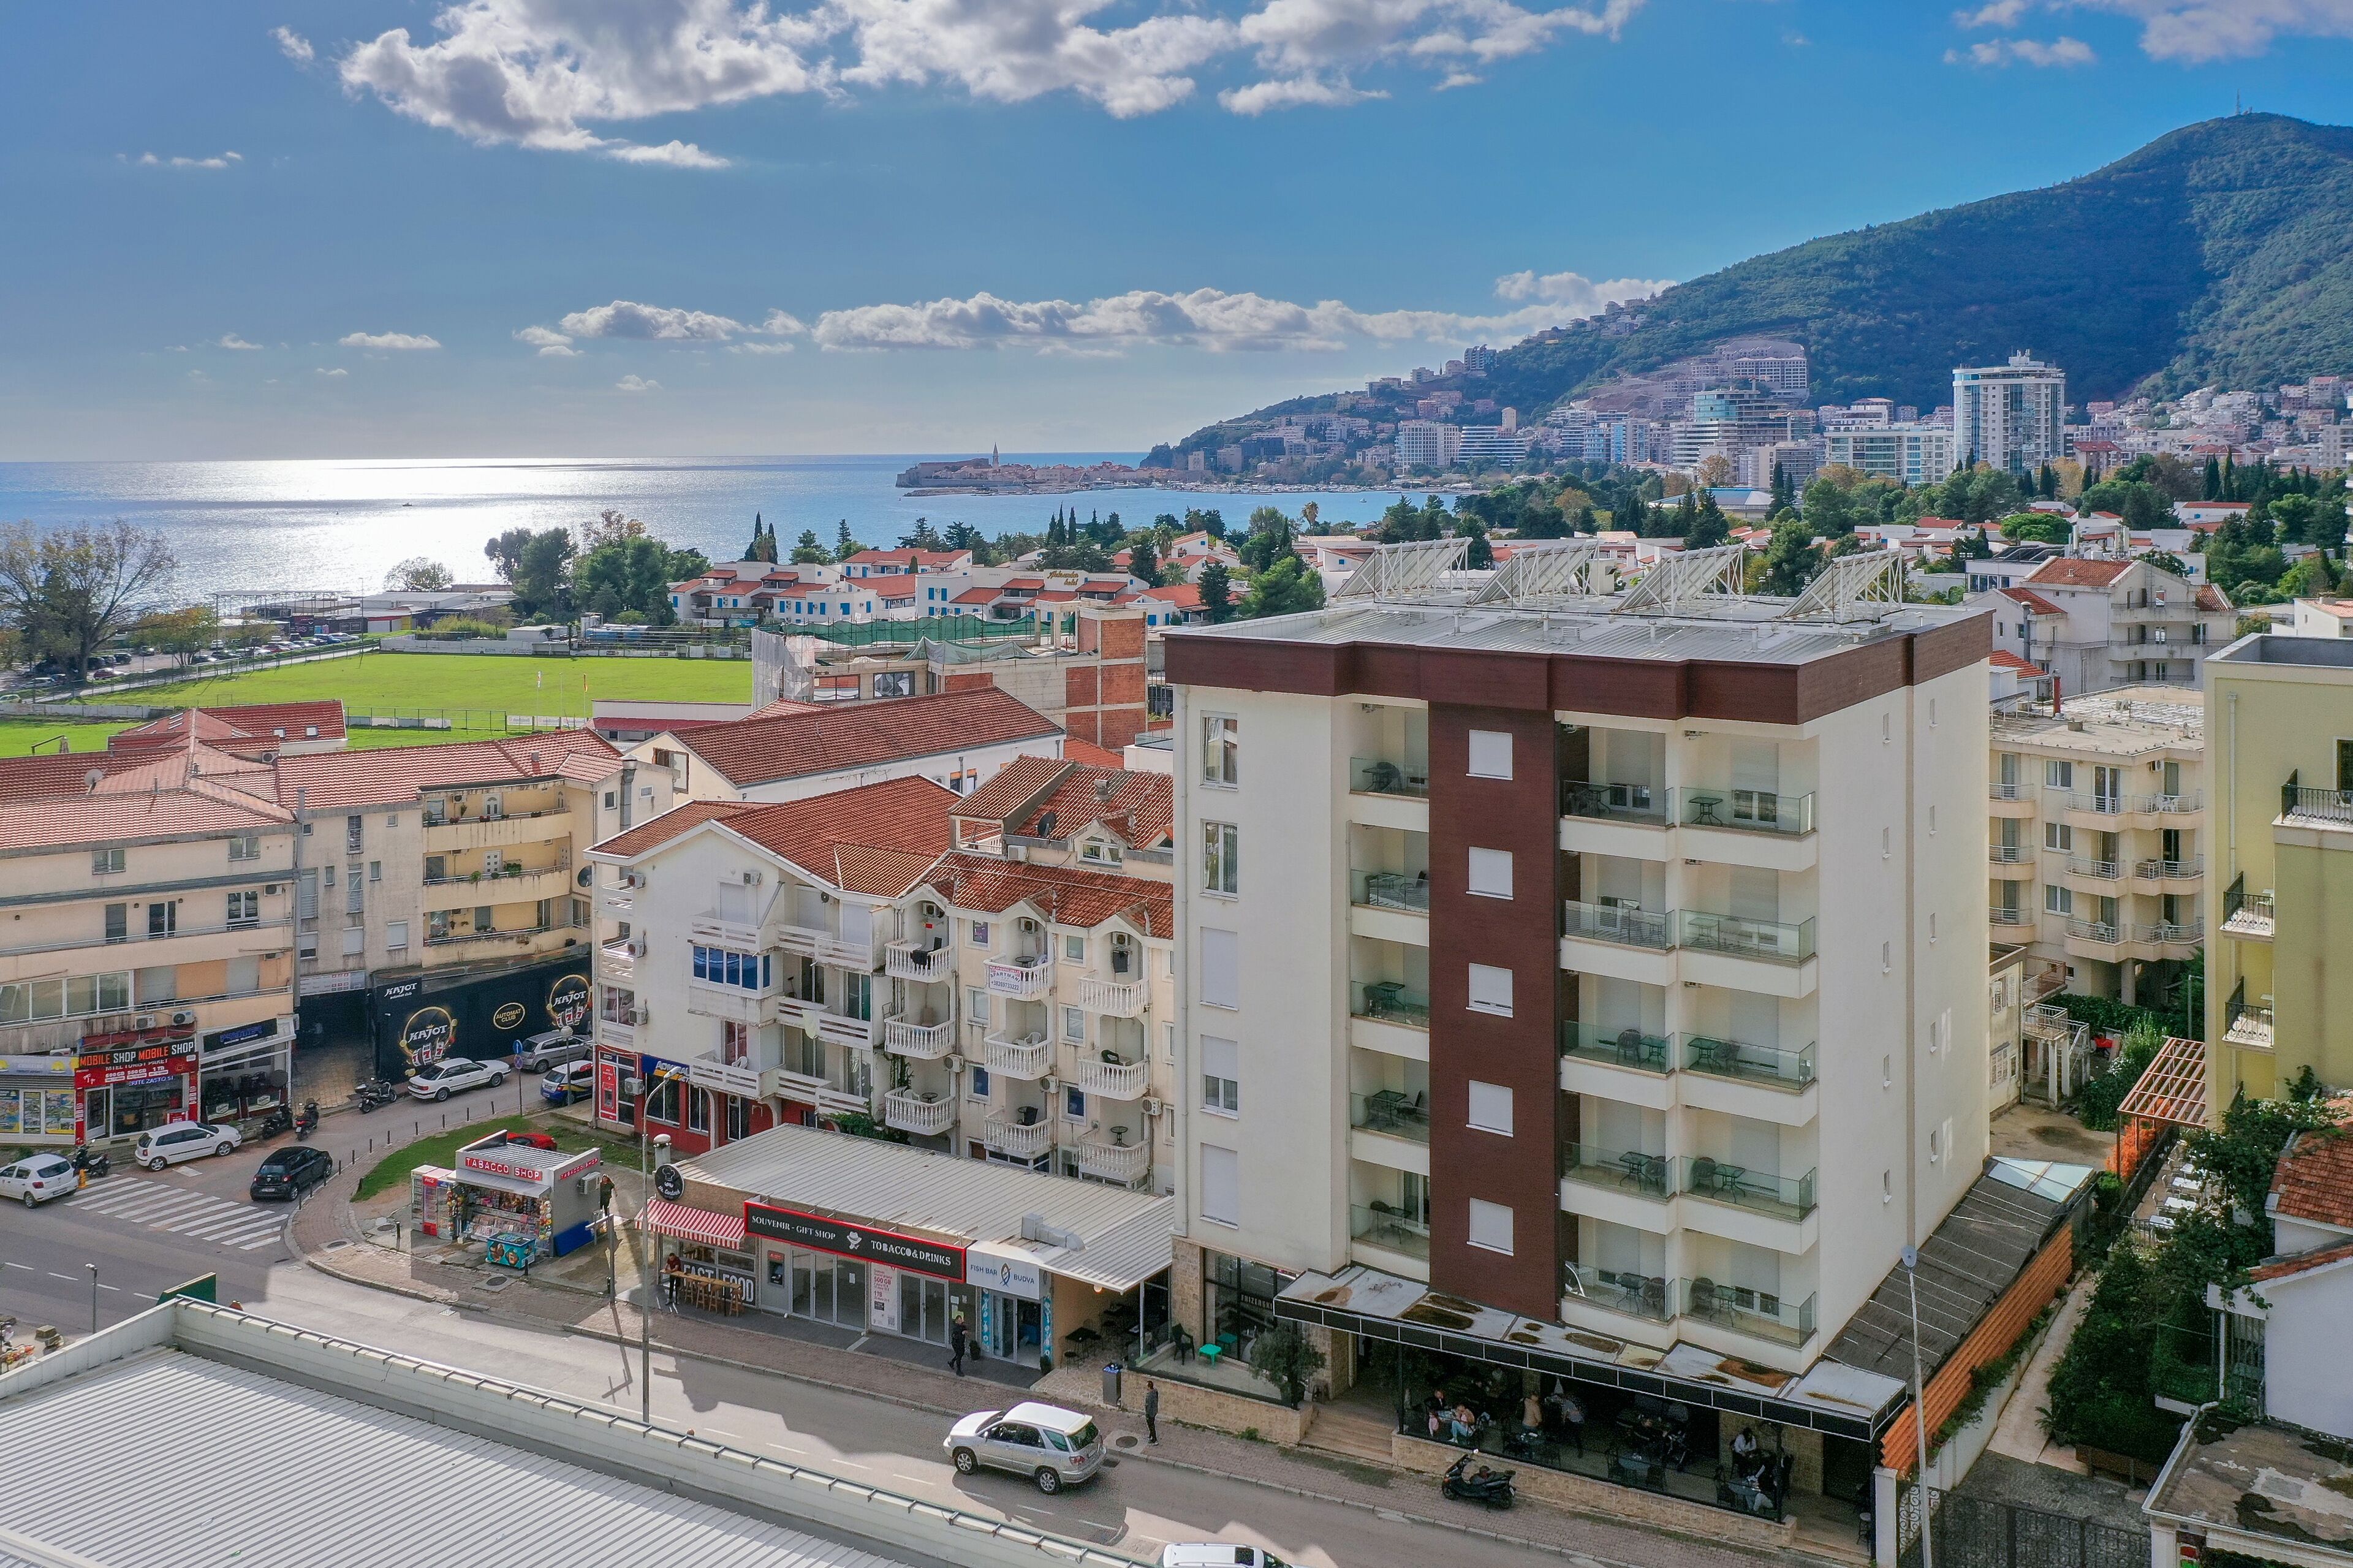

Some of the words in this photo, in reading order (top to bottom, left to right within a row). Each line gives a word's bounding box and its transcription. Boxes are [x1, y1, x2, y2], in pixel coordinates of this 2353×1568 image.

[990, 972, 1020, 982] APARTMANI
[384, 983, 417, 997] KAJOT
[553, 991, 586, 1007] KAJOT
[496, 1009, 522, 1020] AUTOMAT
[407, 1025, 448, 1043] KAJOT
[80, 1054, 110, 1066] MOBILE
[113, 1051, 136, 1063] SHOP
[138, 1046, 169, 1061] MOBILE
[172, 1042, 194, 1055] SHOP
[466, 1157, 509, 1173] TABACCO
[515, 1168, 540, 1180] SHOP
[752, 1215, 790, 1230] SOUVENIR
[797, 1225, 813, 1237] GIFT
[815, 1230, 836, 1240] SHOP
[971, 1264, 984, 1273] FISH
[684, 1264, 714, 1292] FAST
[722, 1273, 754, 1303] FOOD
[1014, 1274, 1034, 1284] BUDVA
